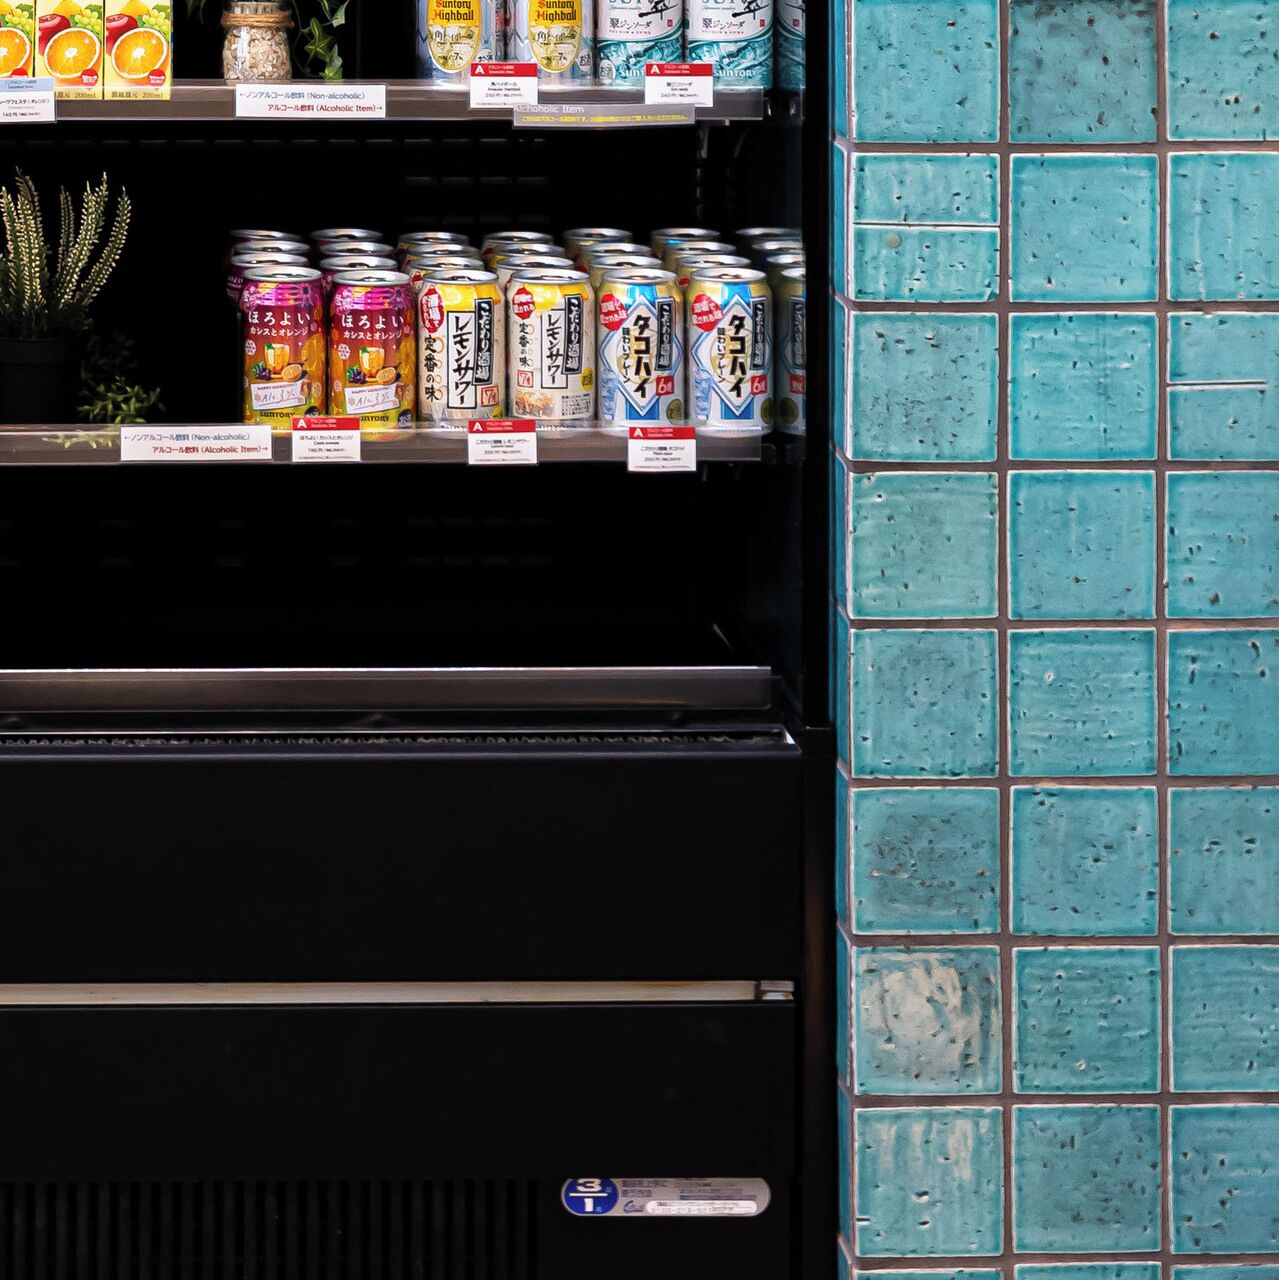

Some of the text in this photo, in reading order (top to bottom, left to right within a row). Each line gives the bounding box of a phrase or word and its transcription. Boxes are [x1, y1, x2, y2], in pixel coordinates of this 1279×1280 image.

[537, 0, 576, 10] Suntory
[433, 9, 474, 22] Highball
[535, 9, 577, 22] Highball
[475, 65, 485, 74] A
[650, 65, 661, 74] A
[246, 91, 304, 100] ノンアルコール飲料
[267, 104, 314, 112] アルコール飲料
[248, 311, 311, 327] ほろよい
[341, 314, 404, 329] ほろよい
[250, 327, 308, 337] カシスとオレンジ
[343, 330, 402, 340] カシスとオレンジ
[518, 322, 530, 368] 定番の味
[546, 313, 563, 385] レモンサワー
[452, 315, 473, 406] レモンサワー
[633, 314, 652, 398] タコハイ
[728, 314, 747, 398] タコハイ
[423, 335, 440, 402] 定番の味
[259, 411, 296, 419] SUNTORY
[297, 419, 307, 428] A
[473, 422, 483, 431] A
[131, 433, 190, 442] ノンアルコール飲料
[633, 428, 644, 437] A
[152, 445, 200, 454] アルコール飲料
